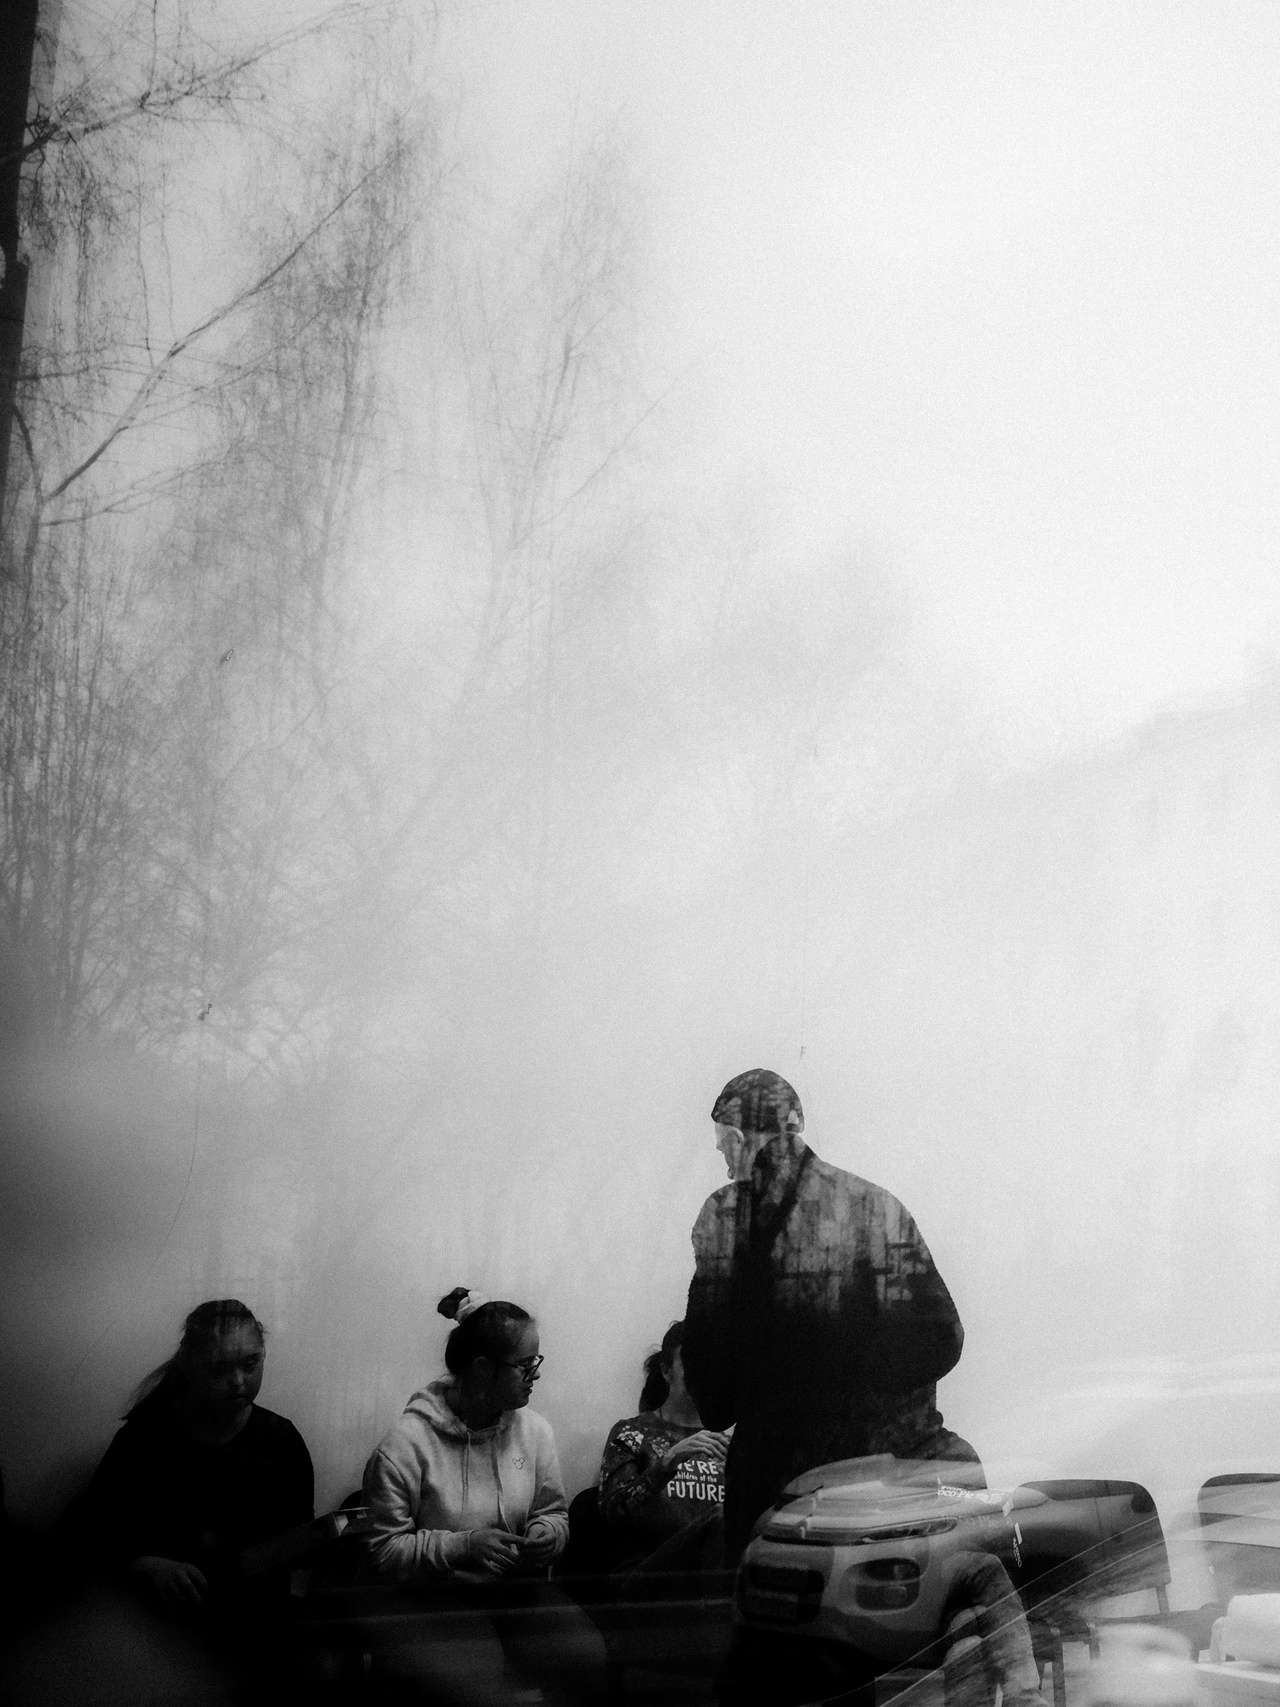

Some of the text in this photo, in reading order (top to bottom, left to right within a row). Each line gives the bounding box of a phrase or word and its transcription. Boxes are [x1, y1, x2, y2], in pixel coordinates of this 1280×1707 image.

[699, 1474, 706, 1482] of
[707, 1475, 718, 1483] the
[667, 1481, 725, 1502] FUTURE
